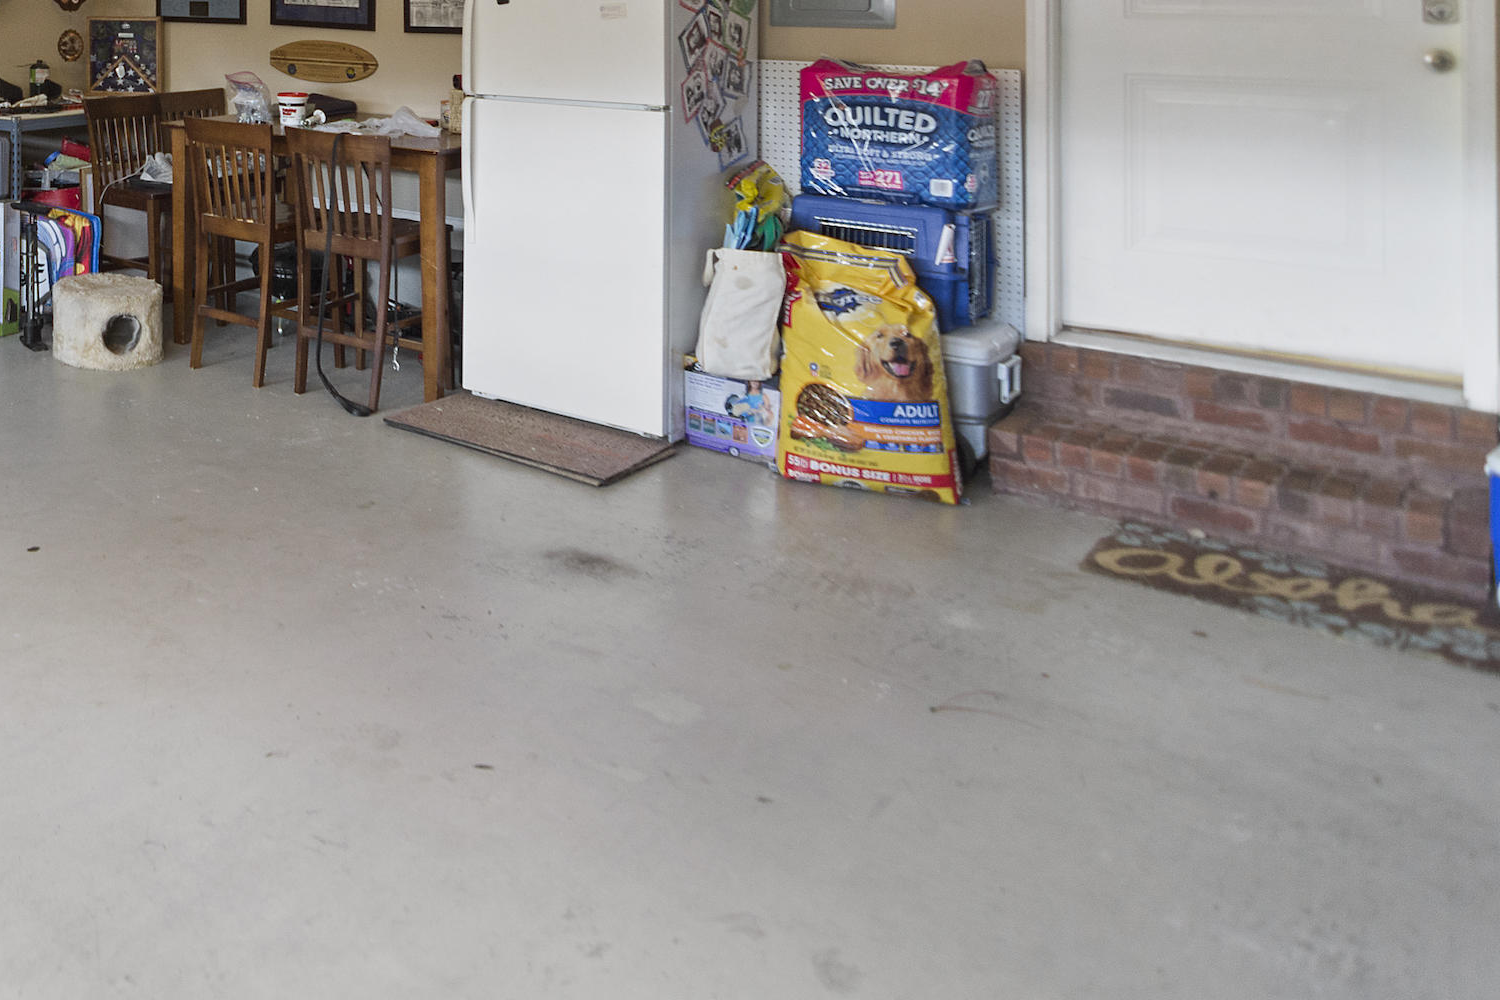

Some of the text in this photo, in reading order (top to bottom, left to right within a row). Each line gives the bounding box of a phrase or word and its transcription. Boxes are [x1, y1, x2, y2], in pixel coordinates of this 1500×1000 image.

[824, 76, 862, 90] SAVE
[865, 77, 909, 93] OVER
[824, 106, 937, 133] QUILTED
[838, 126, 920, 145] NORTHERN
[890, 150, 933, 162] STRONG
[874, 171, 901, 184] 271
[892, 403, 940, 419] ADULT
[810, 460, 861, 478] BONUS
[861, 469, 891, 482] SIZE
